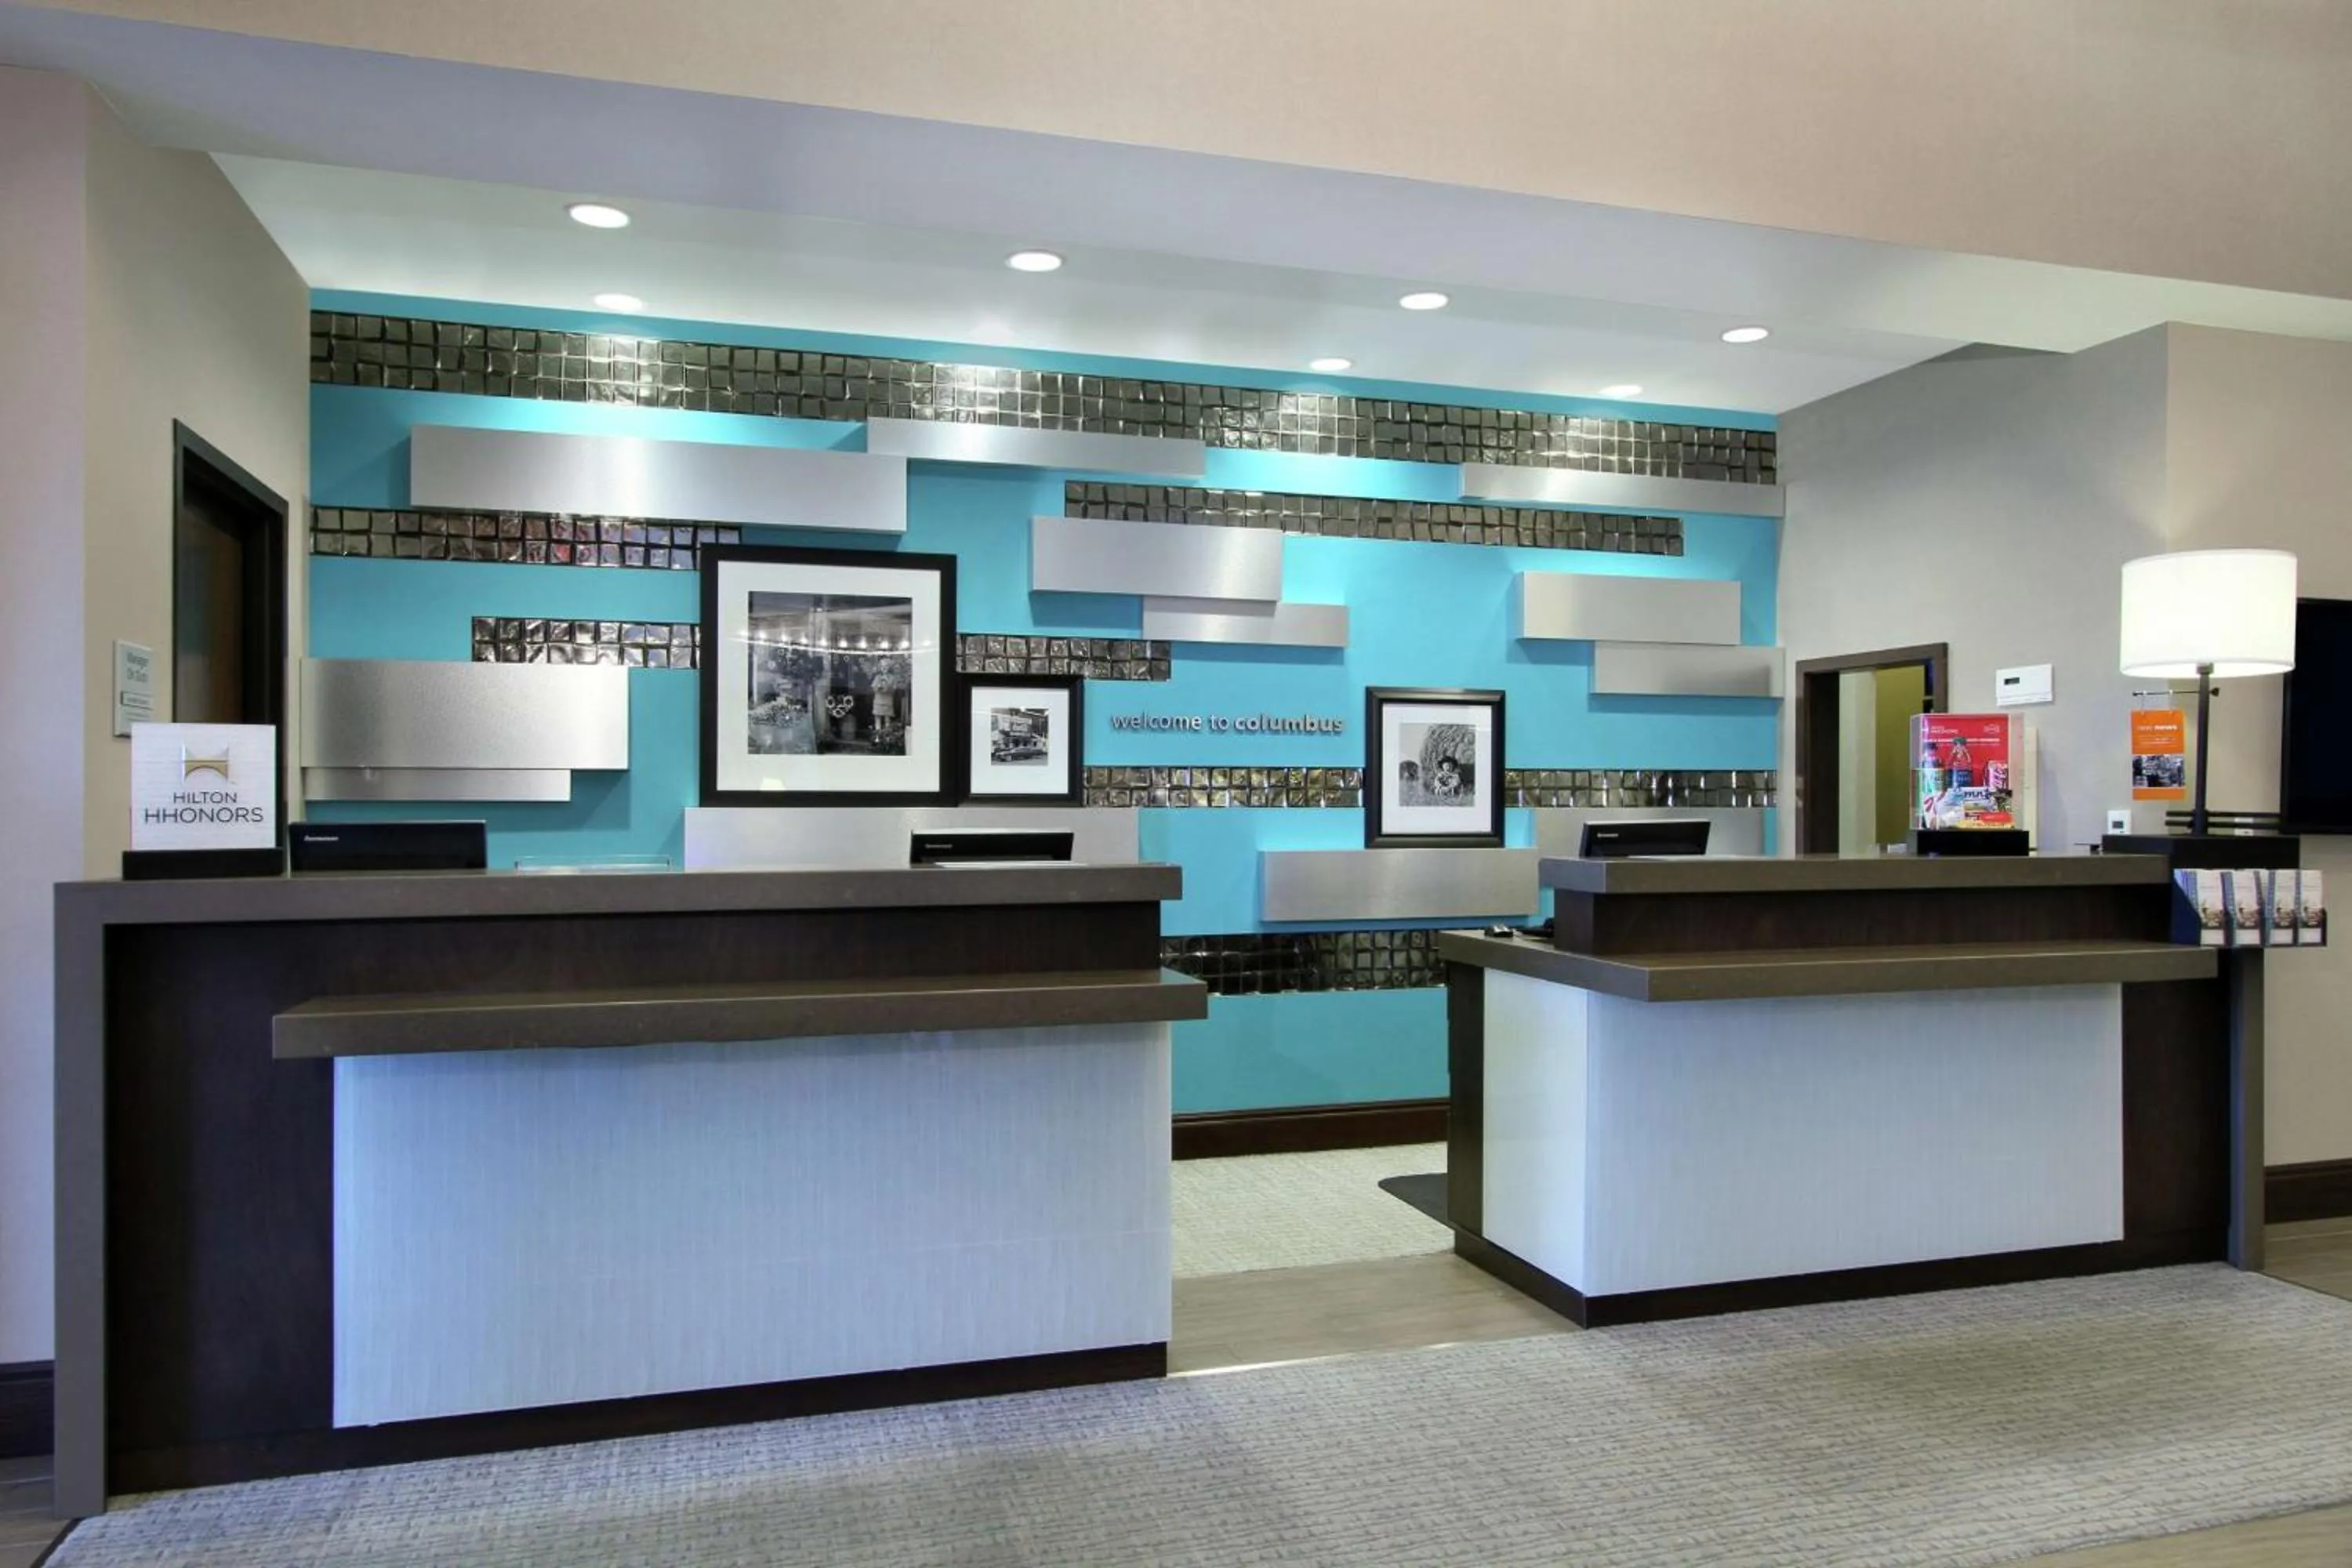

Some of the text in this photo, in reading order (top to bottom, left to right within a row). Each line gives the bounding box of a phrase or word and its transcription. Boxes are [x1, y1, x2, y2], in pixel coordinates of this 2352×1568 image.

[1111, 710, 1343, 734] welcome to columbus
[173, 791, 238, 804] HILTON
[144, 807, 264, 824] HHONORS
